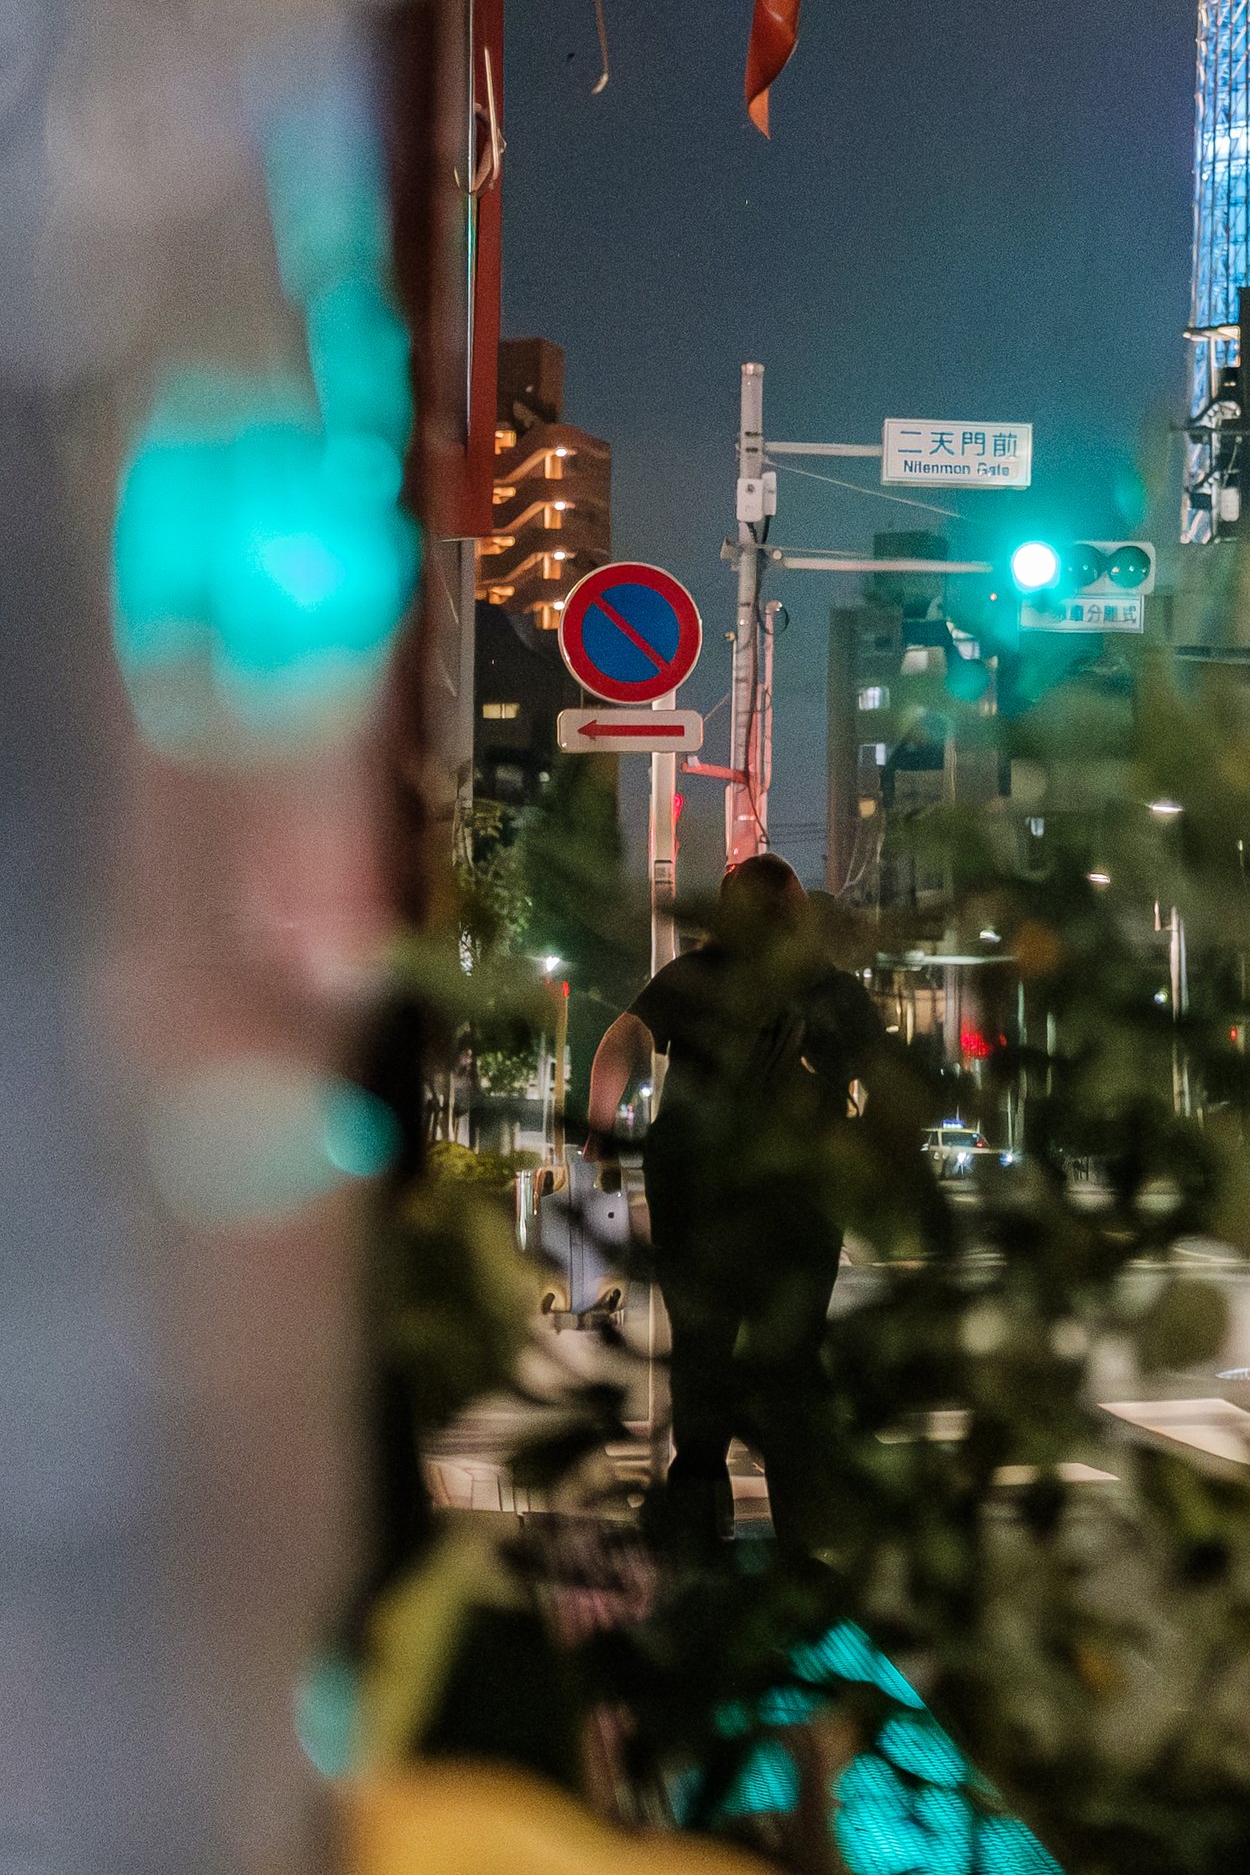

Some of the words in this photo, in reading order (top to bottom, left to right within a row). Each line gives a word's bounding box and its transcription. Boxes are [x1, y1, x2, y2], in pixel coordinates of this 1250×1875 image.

[898, 431, 1017, 457] 二天門前
[904, 460, 970, 475] Nitenmon
[977, 462, 1010, 476] Gate
